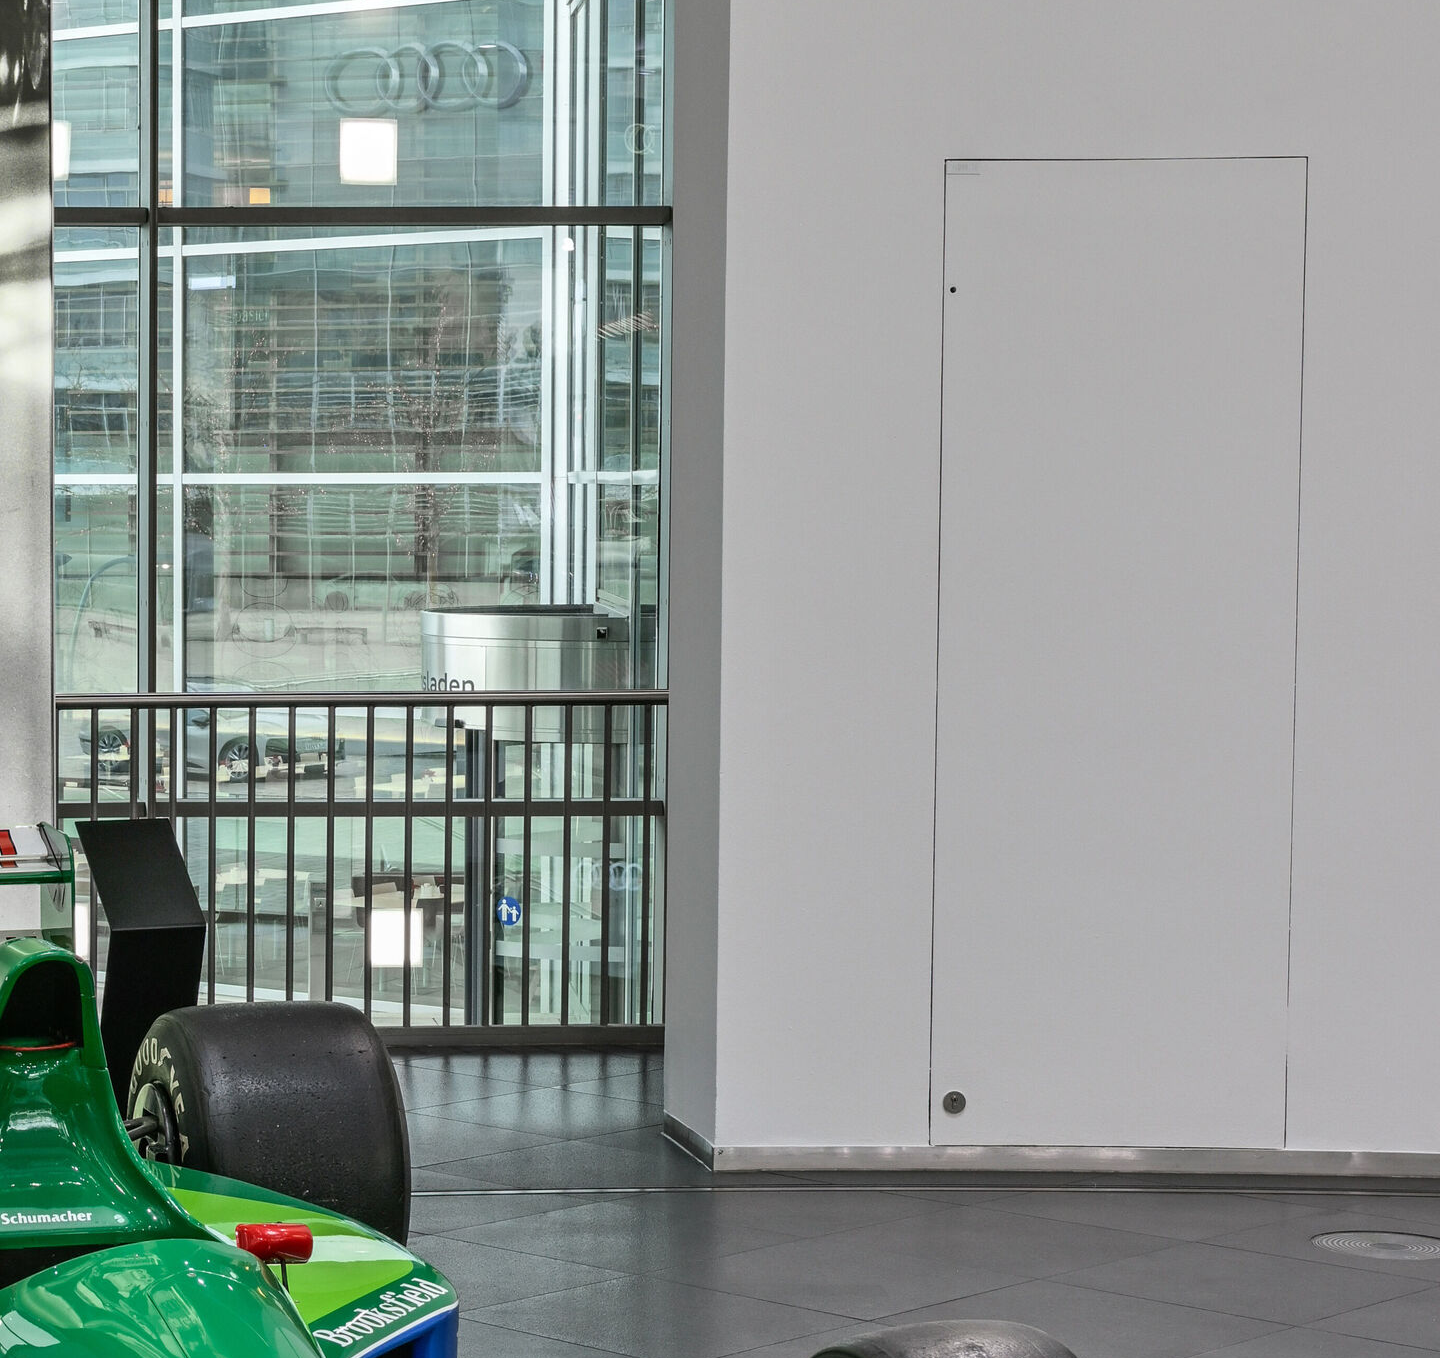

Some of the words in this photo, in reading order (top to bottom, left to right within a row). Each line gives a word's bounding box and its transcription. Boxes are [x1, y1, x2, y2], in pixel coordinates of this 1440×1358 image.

[422, 671, 475, 691] sladen
[0, 1210, 93, 1226] Schumacher
[312, 1277, 449, 1348] Brooksfield
